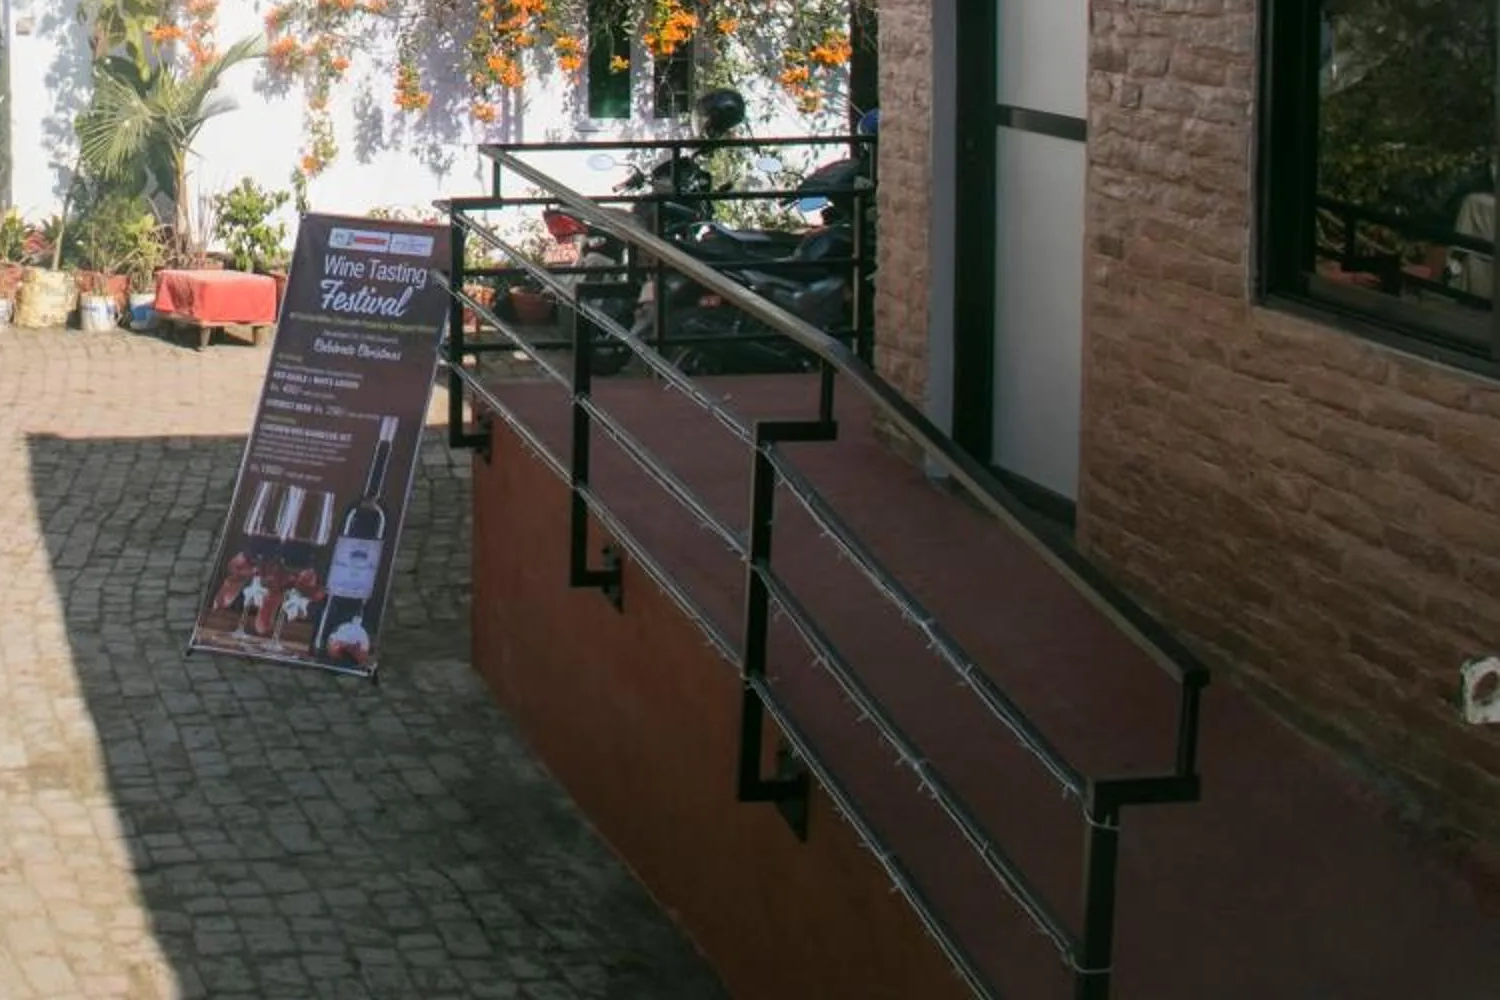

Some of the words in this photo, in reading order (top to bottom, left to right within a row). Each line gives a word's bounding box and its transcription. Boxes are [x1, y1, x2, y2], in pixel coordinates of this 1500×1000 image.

[324, 255, 365, 278] Wine
[369, 259, 428, 289] Tasting
[320, 279, 413, 317] Festival
